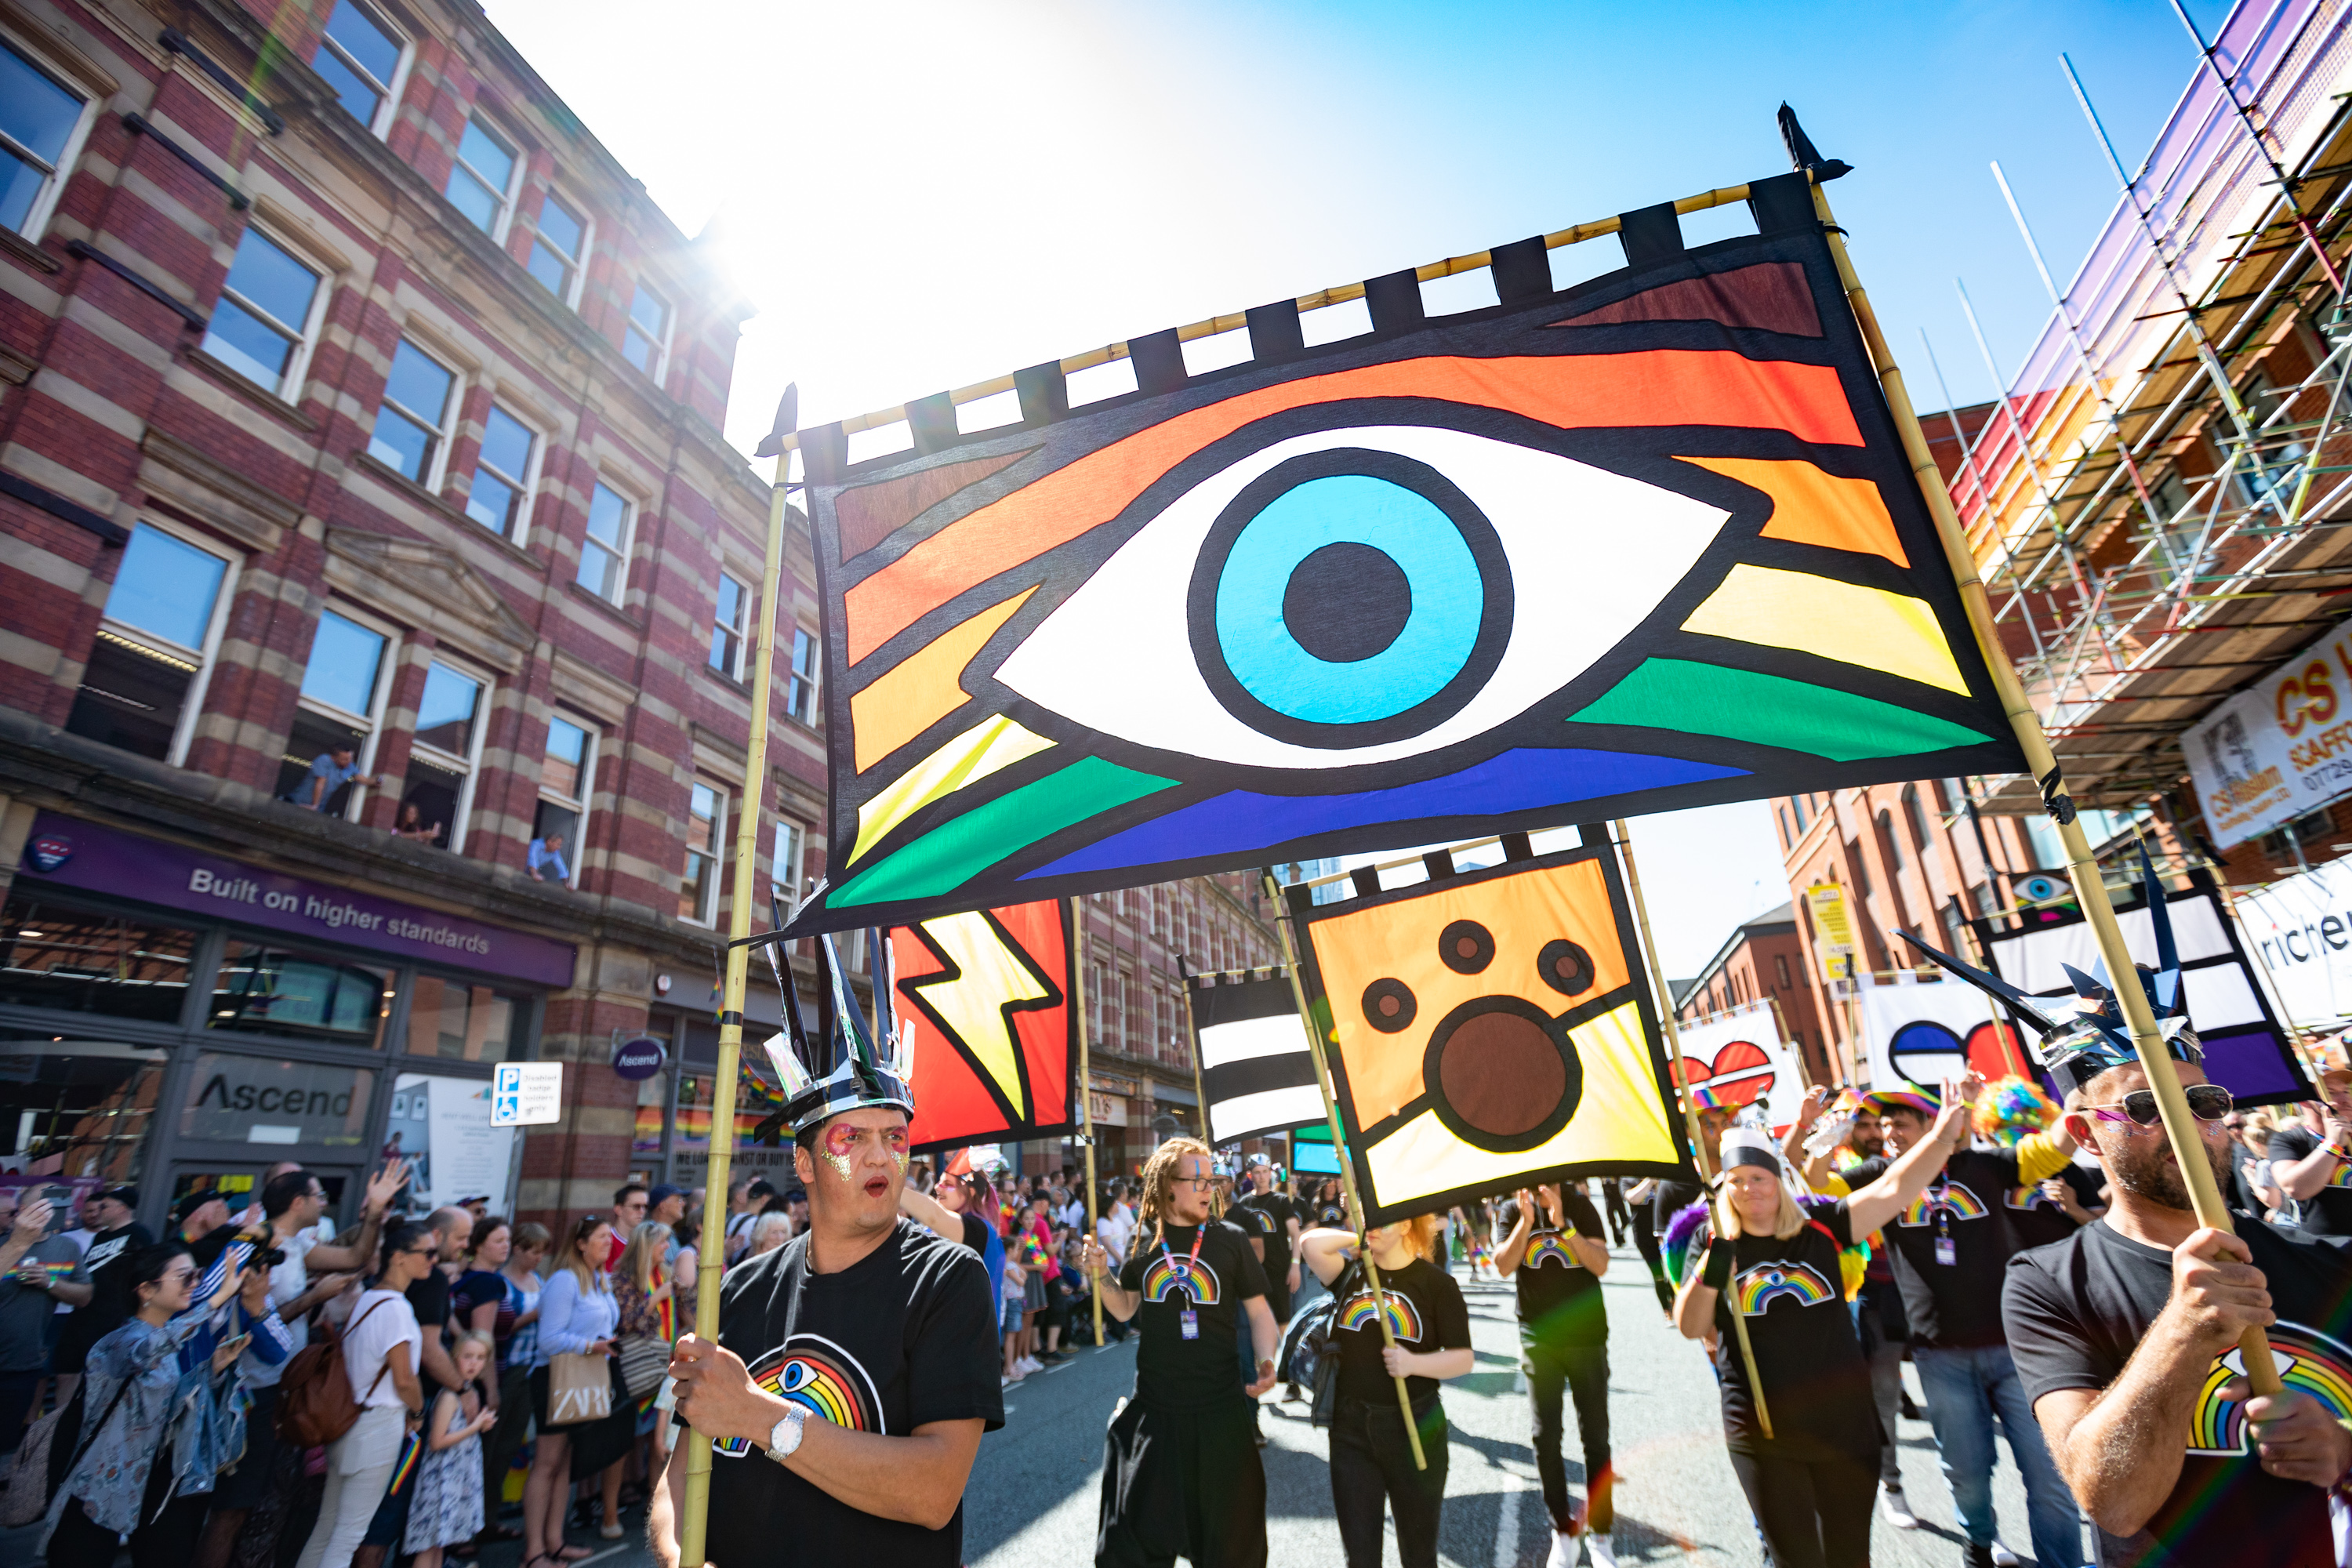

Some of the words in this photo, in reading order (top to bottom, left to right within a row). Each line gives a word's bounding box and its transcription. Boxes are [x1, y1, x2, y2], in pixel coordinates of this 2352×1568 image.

[2277, 659, 2339, 739] CS
[188, 868, 259, 904] Built
[263, 891, 299, 913] on
[303, 895, 383, 928] higher
[386, 917, 491, 955] standards
[2261, 911, 2352, 971] riche
[618, 1052, 659, 1067] Ascend
[195, 1073, 355, 1117] Ascend
